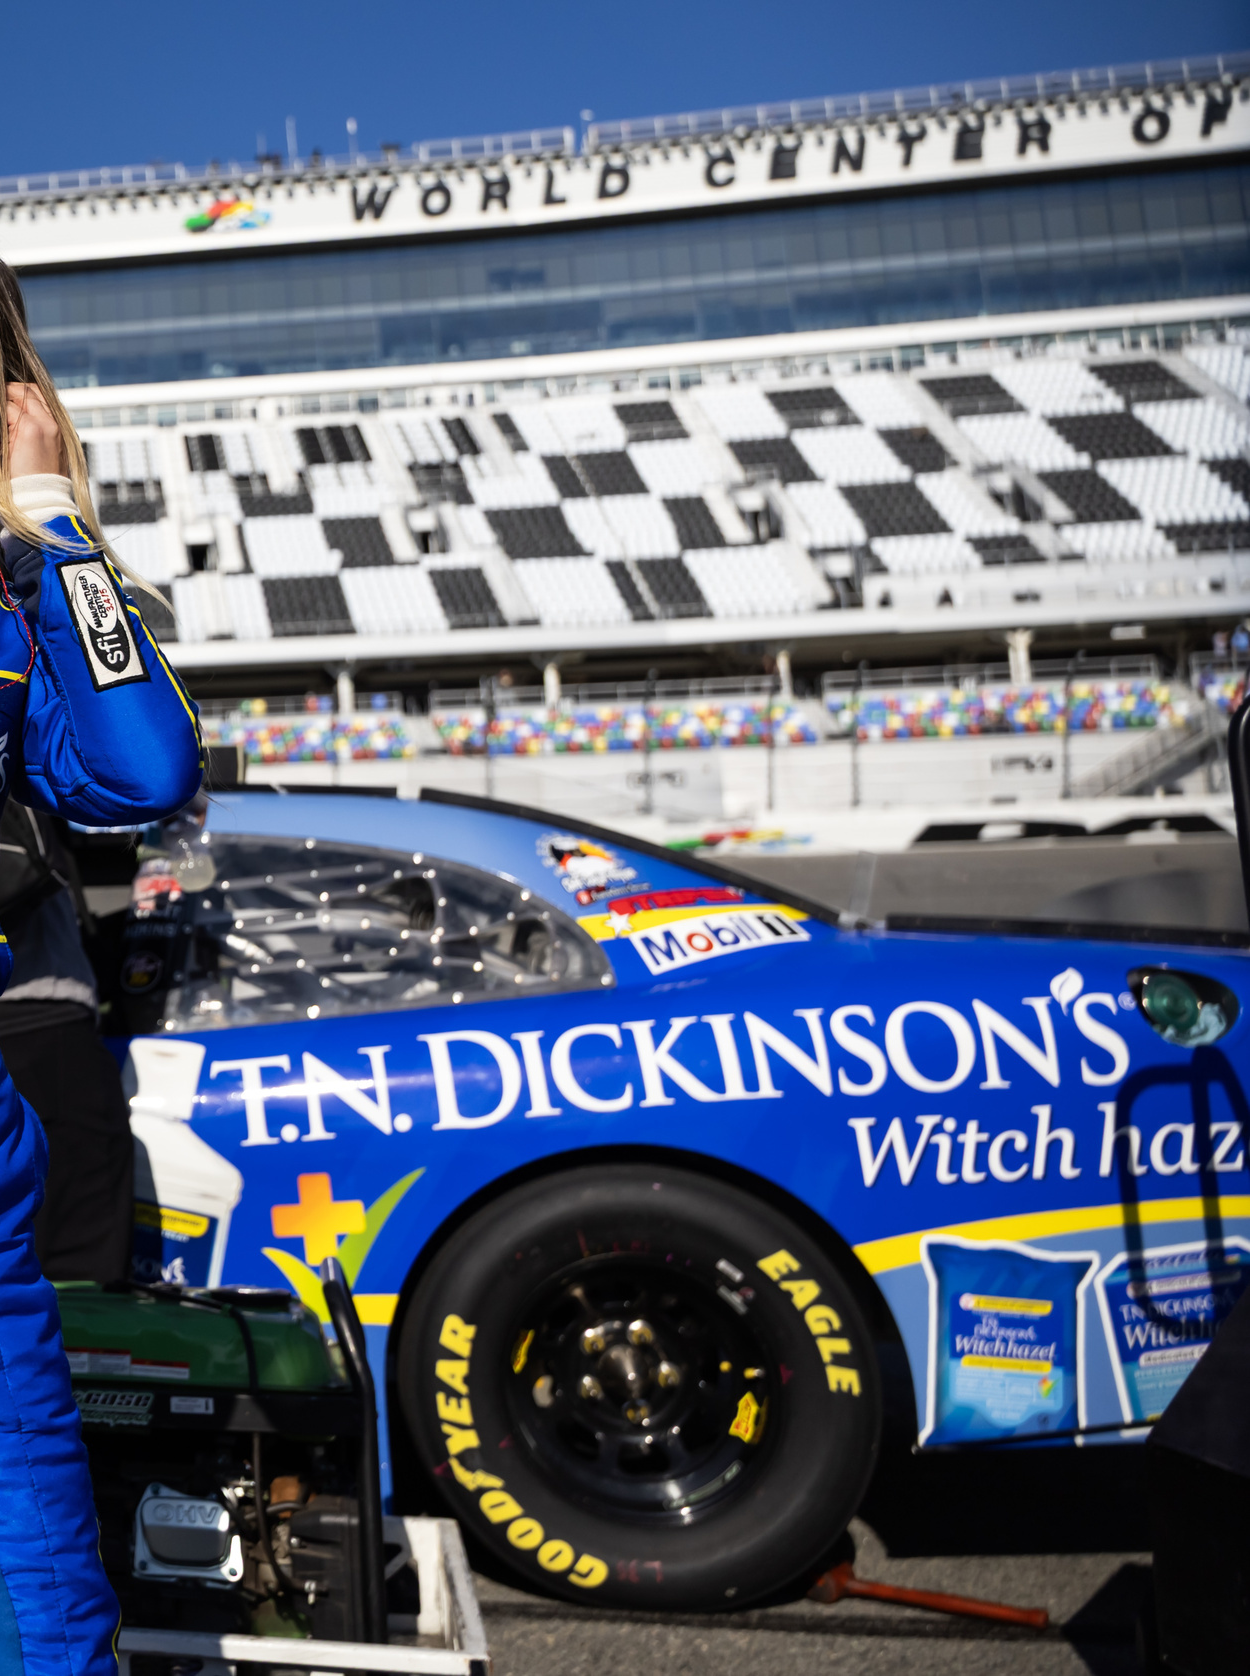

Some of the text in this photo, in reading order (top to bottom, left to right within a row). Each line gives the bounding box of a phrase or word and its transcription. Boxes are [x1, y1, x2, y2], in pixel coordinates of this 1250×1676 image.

[352, 160, 630, 222] WORLD
[703, 112, 1052, 190] CENTER
[78, 575, 104, 629] MANUFACTURER
[90, 583, 108, 619] CERTIFIED
[640, 914, 761, 966] Mobil
[210, 967, 1130, 1148] T.N. DICKINSON'S
[847, 1103, 1082, 1188] Witch
[756, 1248, 863, 1397] EAGLE
[435, 1313, 610, 1589] GOODYEAR
[152, 1502, 219, 1524] OHV
